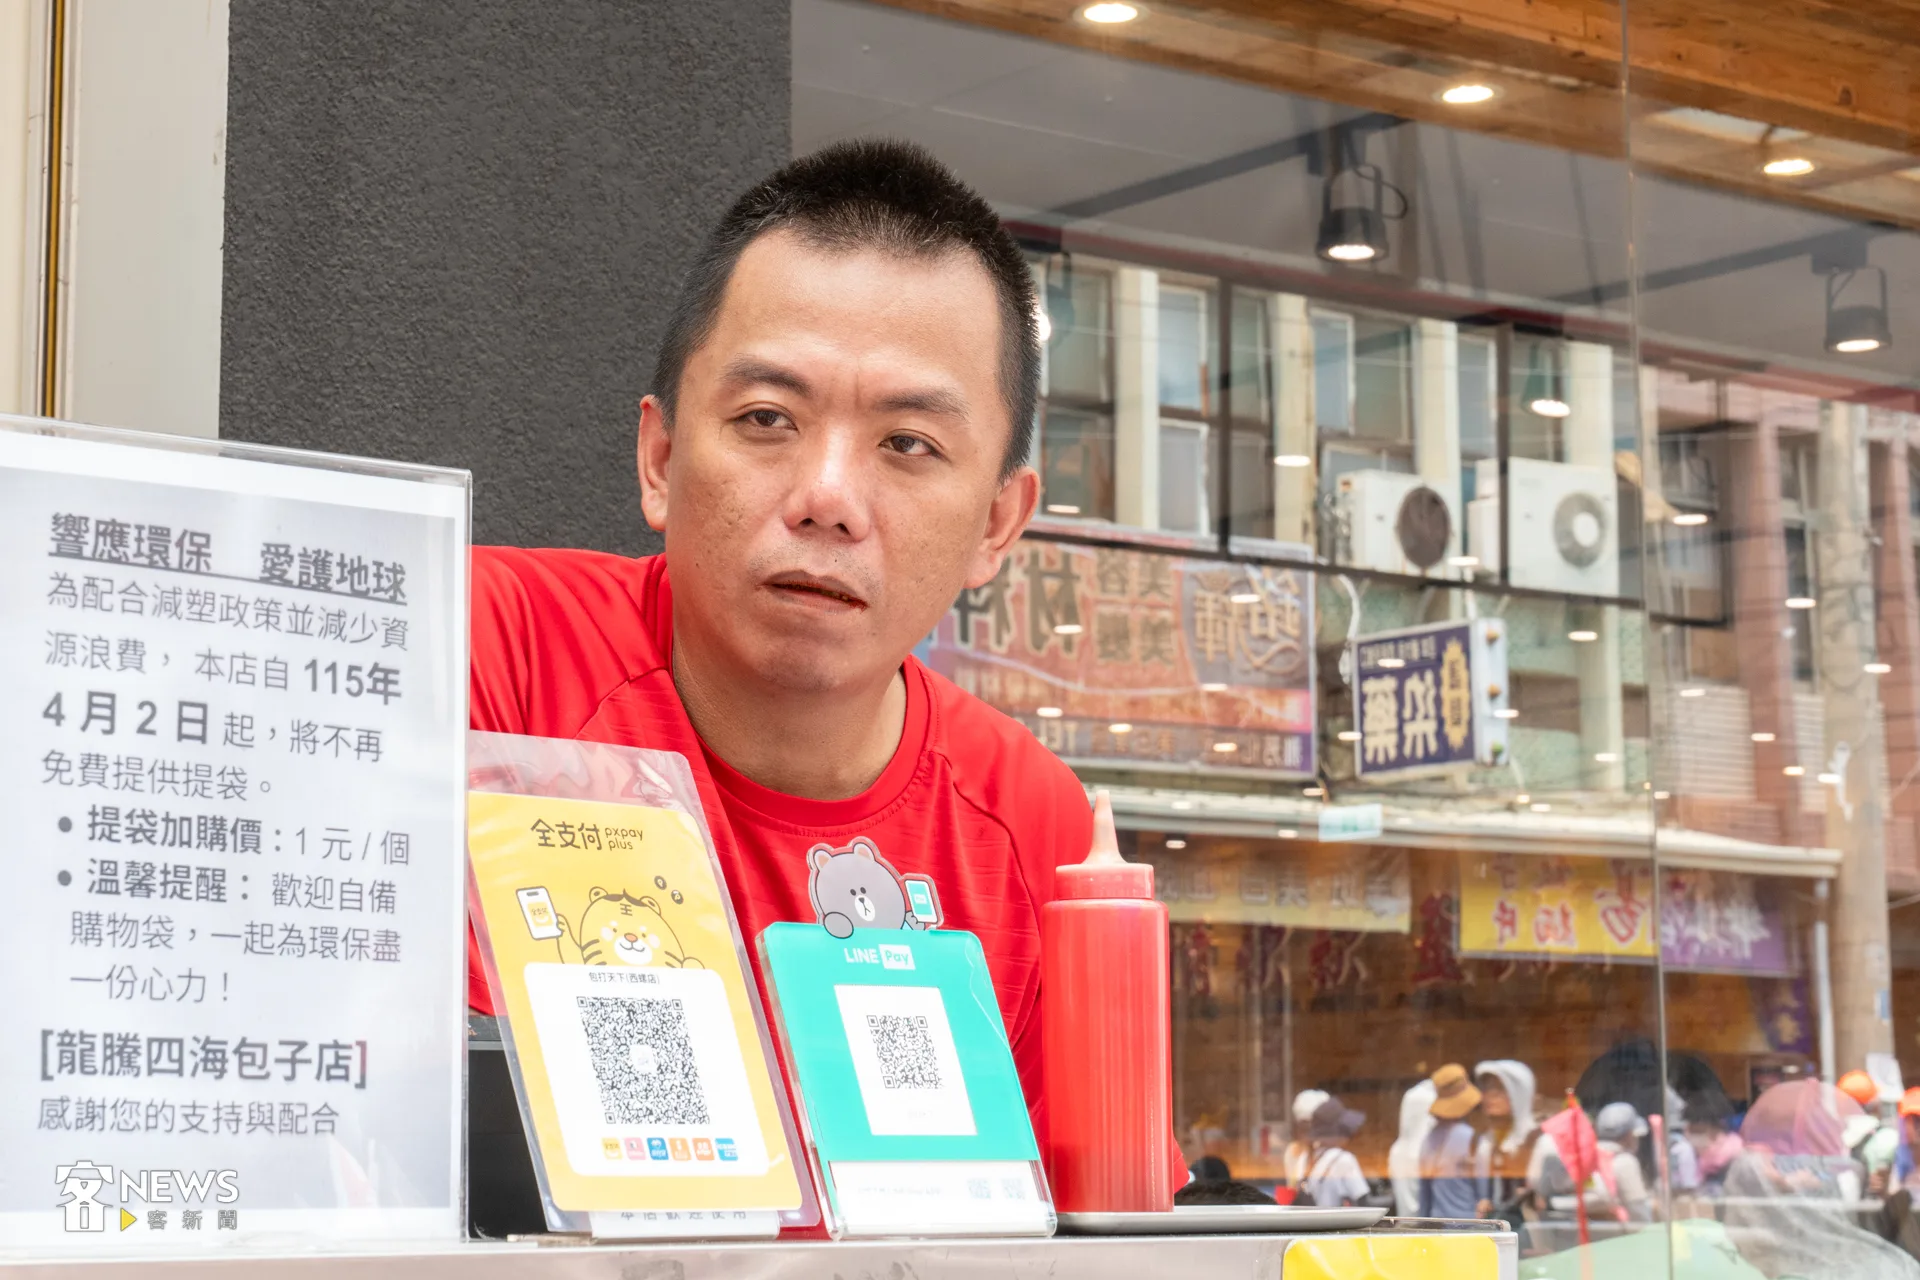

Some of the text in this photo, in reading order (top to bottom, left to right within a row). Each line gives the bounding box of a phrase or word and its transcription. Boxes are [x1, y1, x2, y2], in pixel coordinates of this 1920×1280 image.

[48, 511, 408, 604] 響應環保 愛護地球
[46, 572, 409, 652] 為配合減塑政策並減少資
[303, 658, 403, 706] 115年
[41, 748, 272, 802] 免費提供提袋。
[530, 818, 603, 851] 全支付
[604, 827, 644, 842] pxpay
[608, 838, 634, 852] plus
[70, 910, 402, 963] 購物袋，一起為環保盡
[843, 947, 909, 966] LINE Pay
[70, 964, 229, 1004] 一份心力！
[40, 1028, 368, 1091] [龍騰四海包子店]
[38, 1096, 340, 1136] 感謝您的支持與配合
